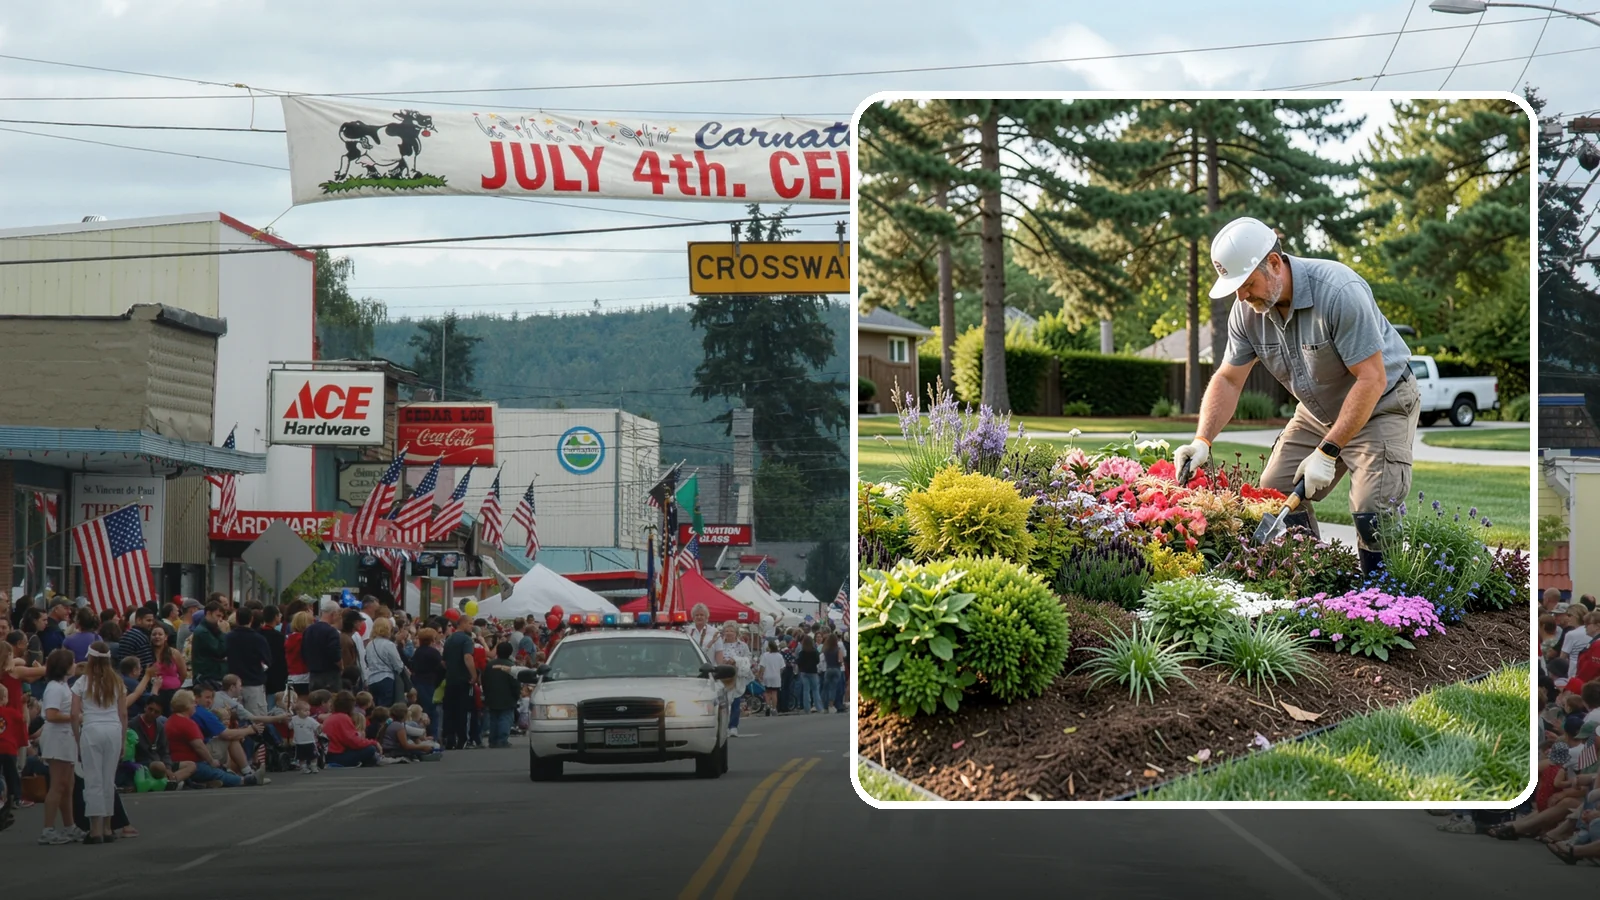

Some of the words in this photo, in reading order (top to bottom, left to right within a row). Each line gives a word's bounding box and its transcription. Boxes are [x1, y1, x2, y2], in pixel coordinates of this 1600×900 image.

[481, 141, 604, 192] JULY
[632, 149, 746, 197] 4th.
[697, 253, 850, 279] CROSSWA
[283, 380, 373, 420] ACE
[406, 410, 453, 422] CEDAR
[284, 421, 370, 436] Hardware
[353, 467, 384, 481] Simpl
[83, 486, 93, 494] St.
[96, 485, 124, 495] Vincent
[126, 486, 135, 494] de
[137, 486, 155, 495] Paul
[688, 527, 741, 535] CRNATION
[699, 535, 730, 543] GLASS
